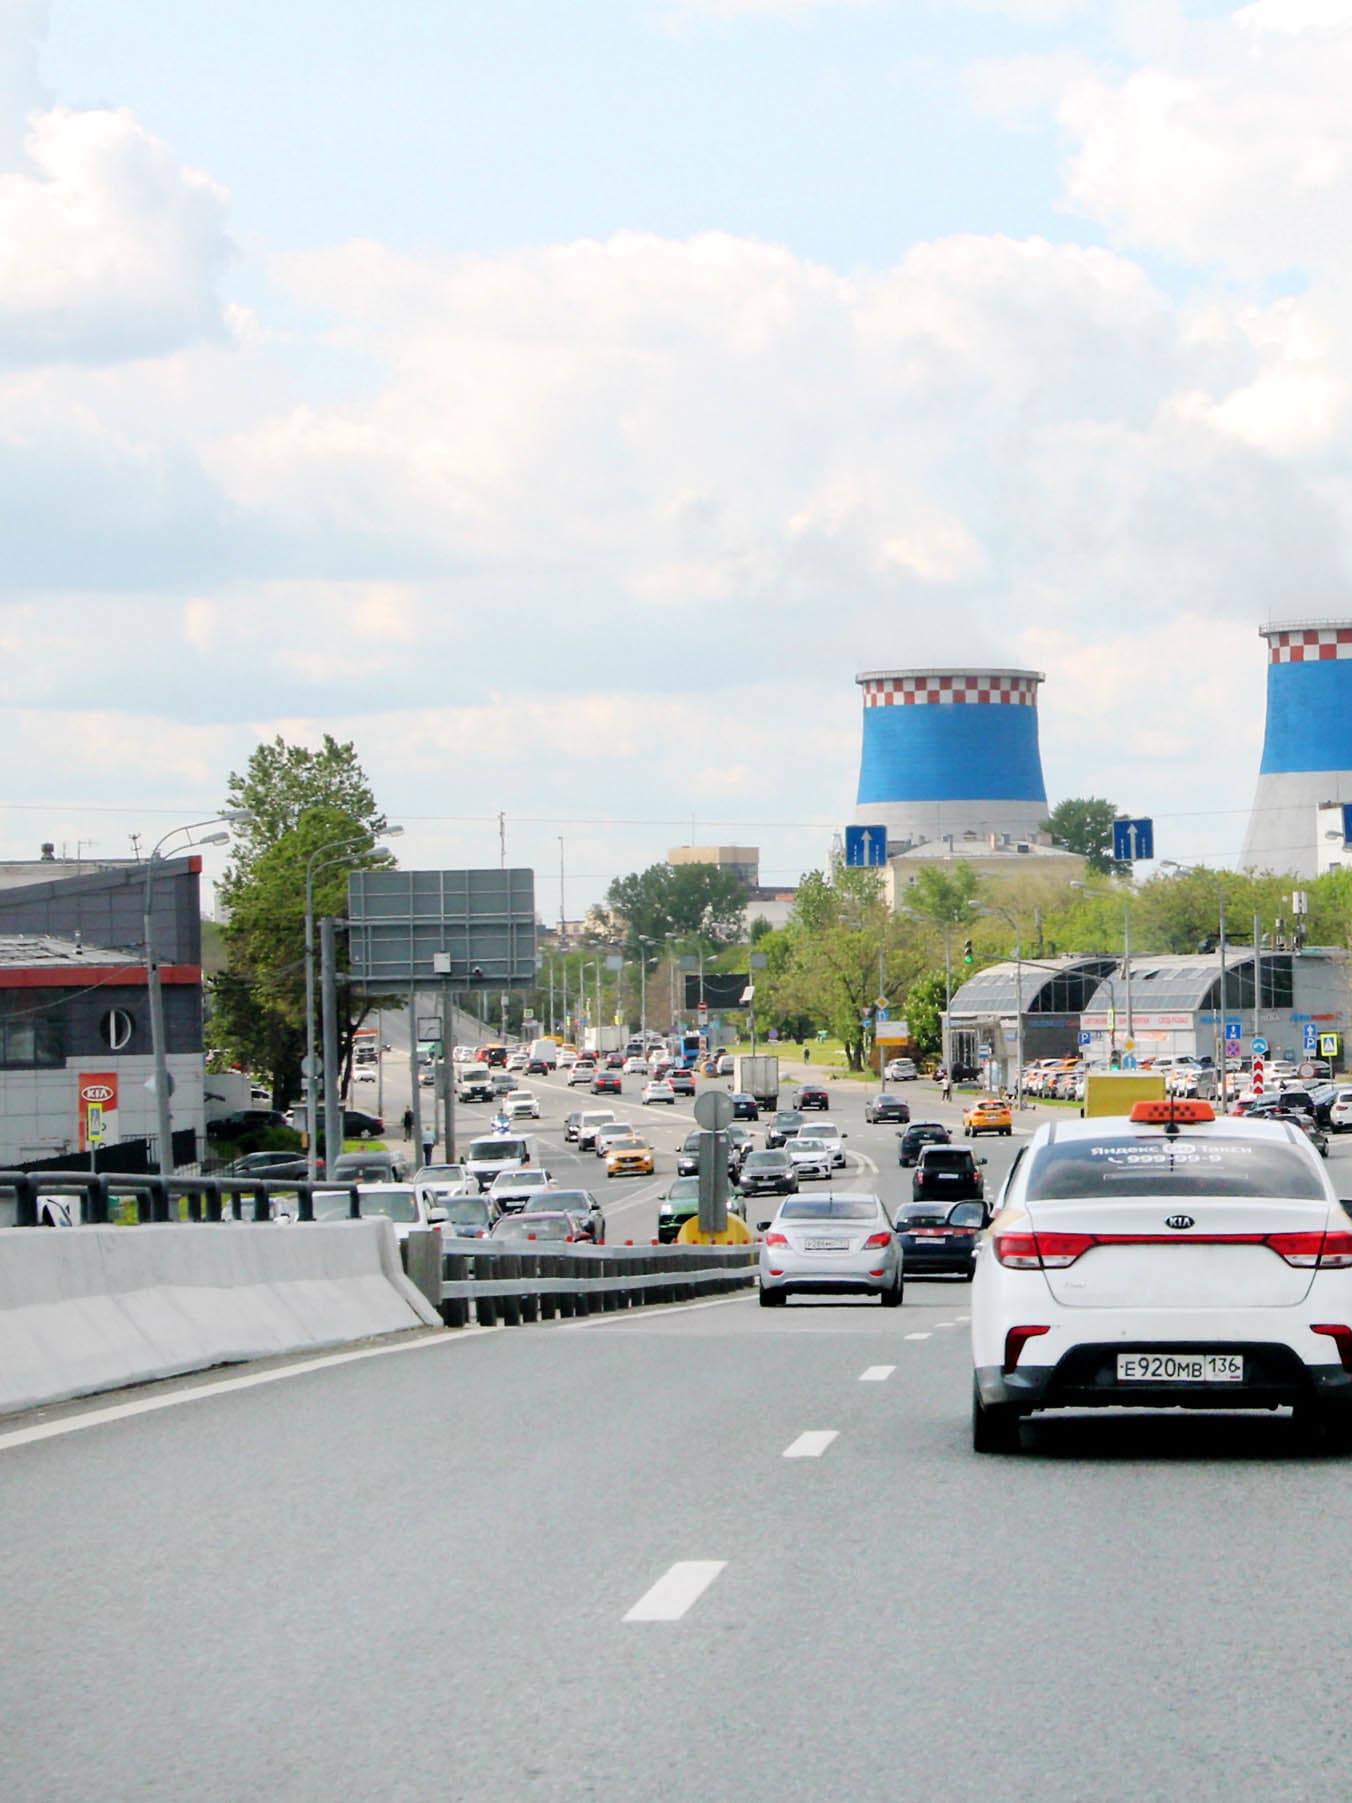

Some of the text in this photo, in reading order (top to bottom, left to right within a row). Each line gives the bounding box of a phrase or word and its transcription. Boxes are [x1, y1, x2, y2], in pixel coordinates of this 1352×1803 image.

[1091, 1144, 1159, 1155] Яндекс
[1166, 1216, 1193, 1228] KIA
[1125, 1358, 1236, 1378] Е920МВ 136
